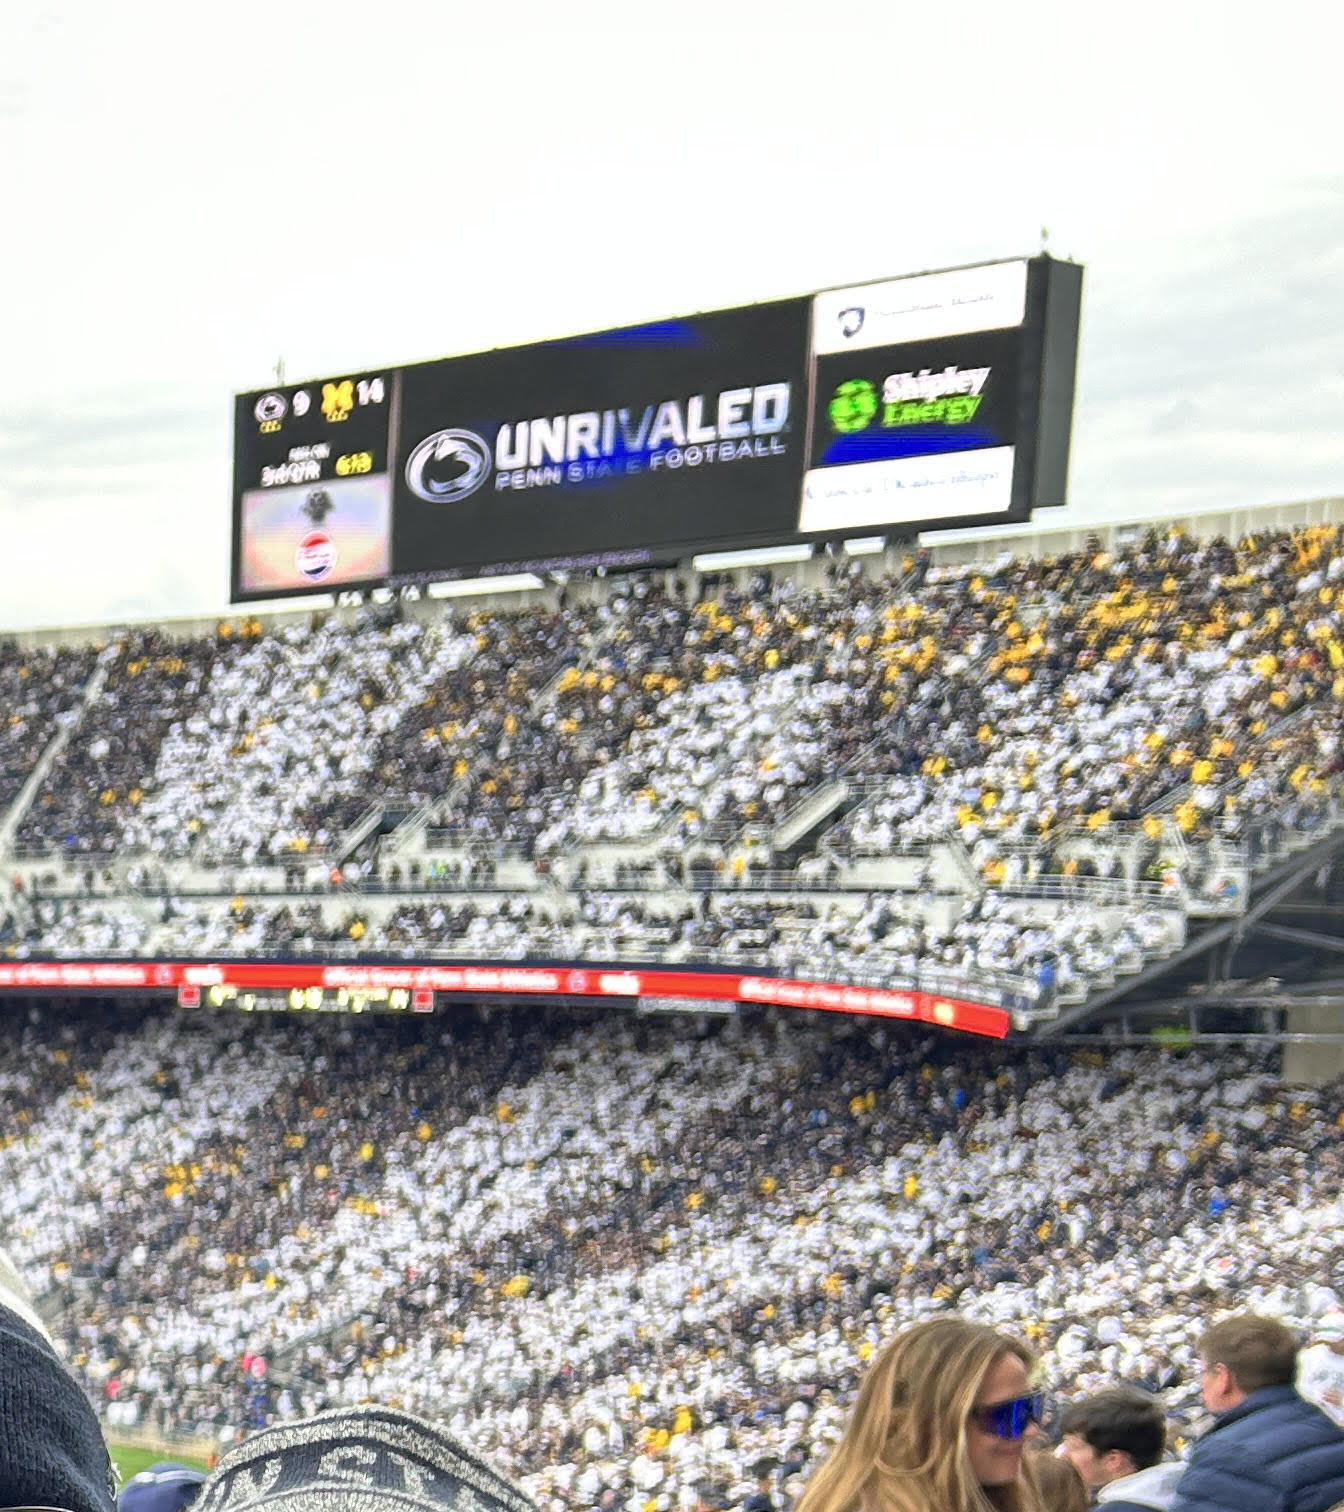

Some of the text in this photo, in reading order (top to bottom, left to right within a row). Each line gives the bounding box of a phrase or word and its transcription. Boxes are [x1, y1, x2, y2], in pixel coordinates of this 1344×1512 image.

[356, 376, 386, 406] 14
[882, 366, 992, 403] Shipley
[495, 381, 792, 470] UNRIVALED
[495, 435, 787, 492] PENN STATE FOOTBALL
